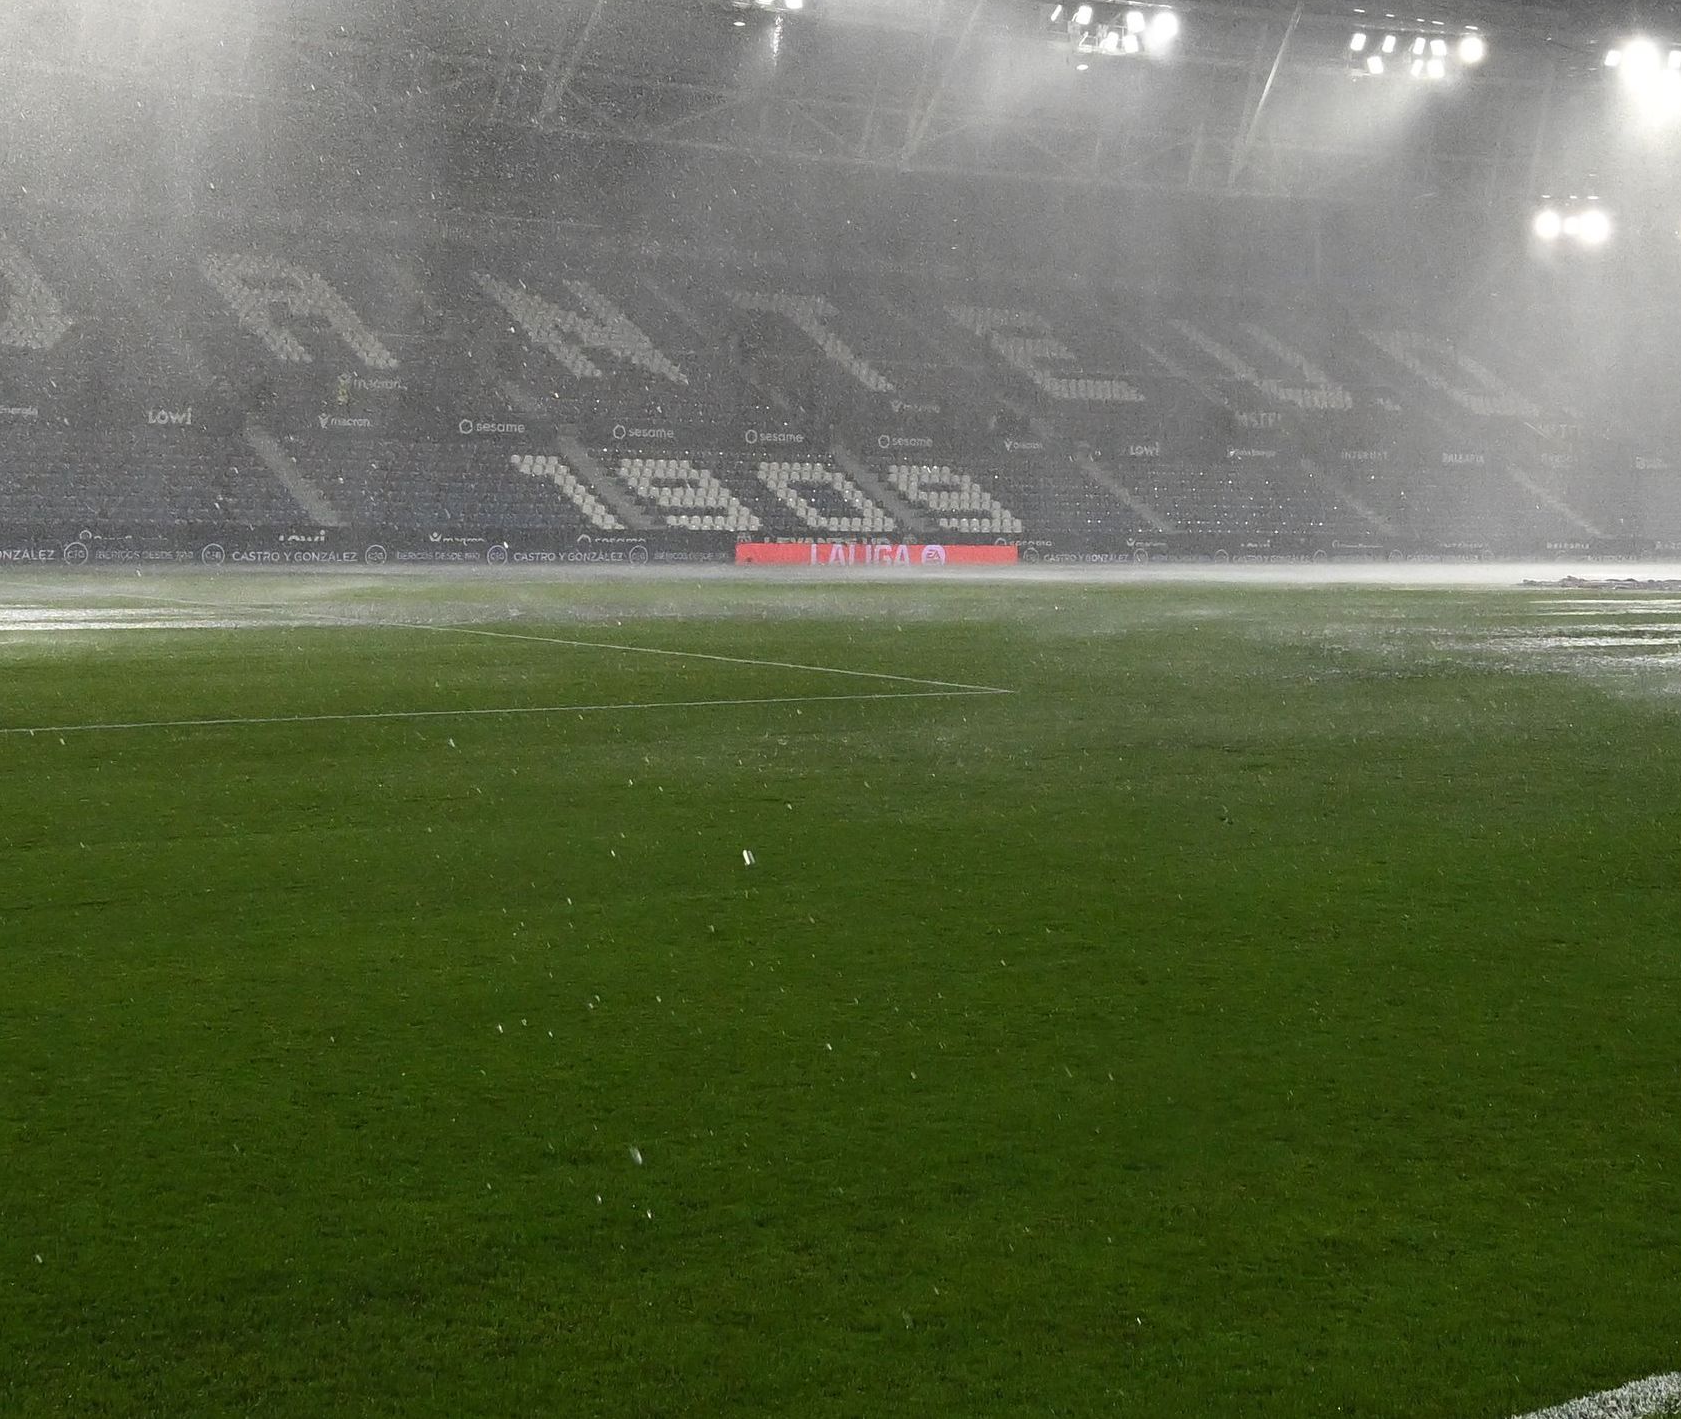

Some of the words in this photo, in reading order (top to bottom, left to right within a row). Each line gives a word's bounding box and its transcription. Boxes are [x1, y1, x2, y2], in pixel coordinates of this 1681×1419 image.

[476, 422, 525, 433] sesame
[628, 427, 674, 439] sesame
[759, 433, 804, 443] sesame
[892, 437, 933, 447] sesame
[511, 454, 1023, 534] 1909
[232, 550, 280, 562] CASTRO
[283, 551, 292, 562] Y
[514, 552, 556, 562] CASTRO
[559, 552, 567, 562] Y
